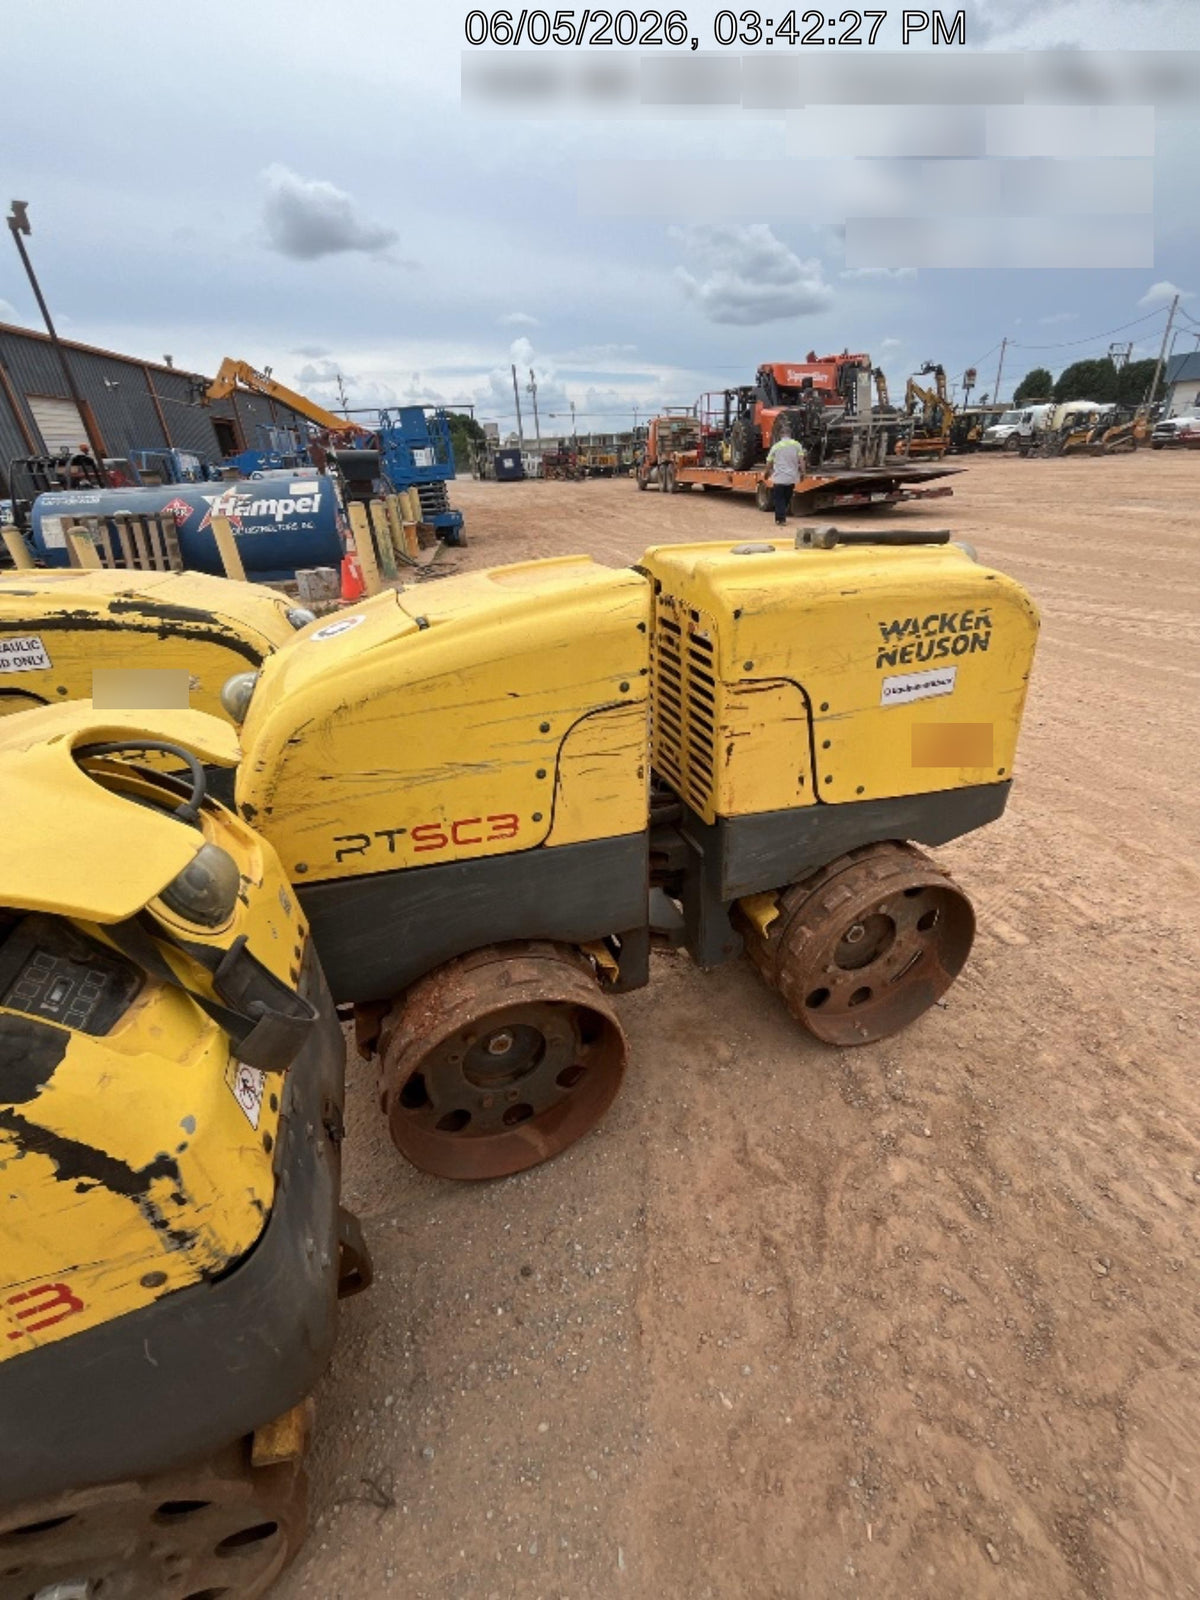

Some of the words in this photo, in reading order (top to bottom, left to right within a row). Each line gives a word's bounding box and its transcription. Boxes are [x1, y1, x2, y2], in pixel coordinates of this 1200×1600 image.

[211, 493, 322, 522] Hampel
[877, 607, 993, 644] WACKER
[0, 657, 11, 669] D
[13, 654, 44, 668] ONLY
[876, 630, 991, 669] NEUSON
